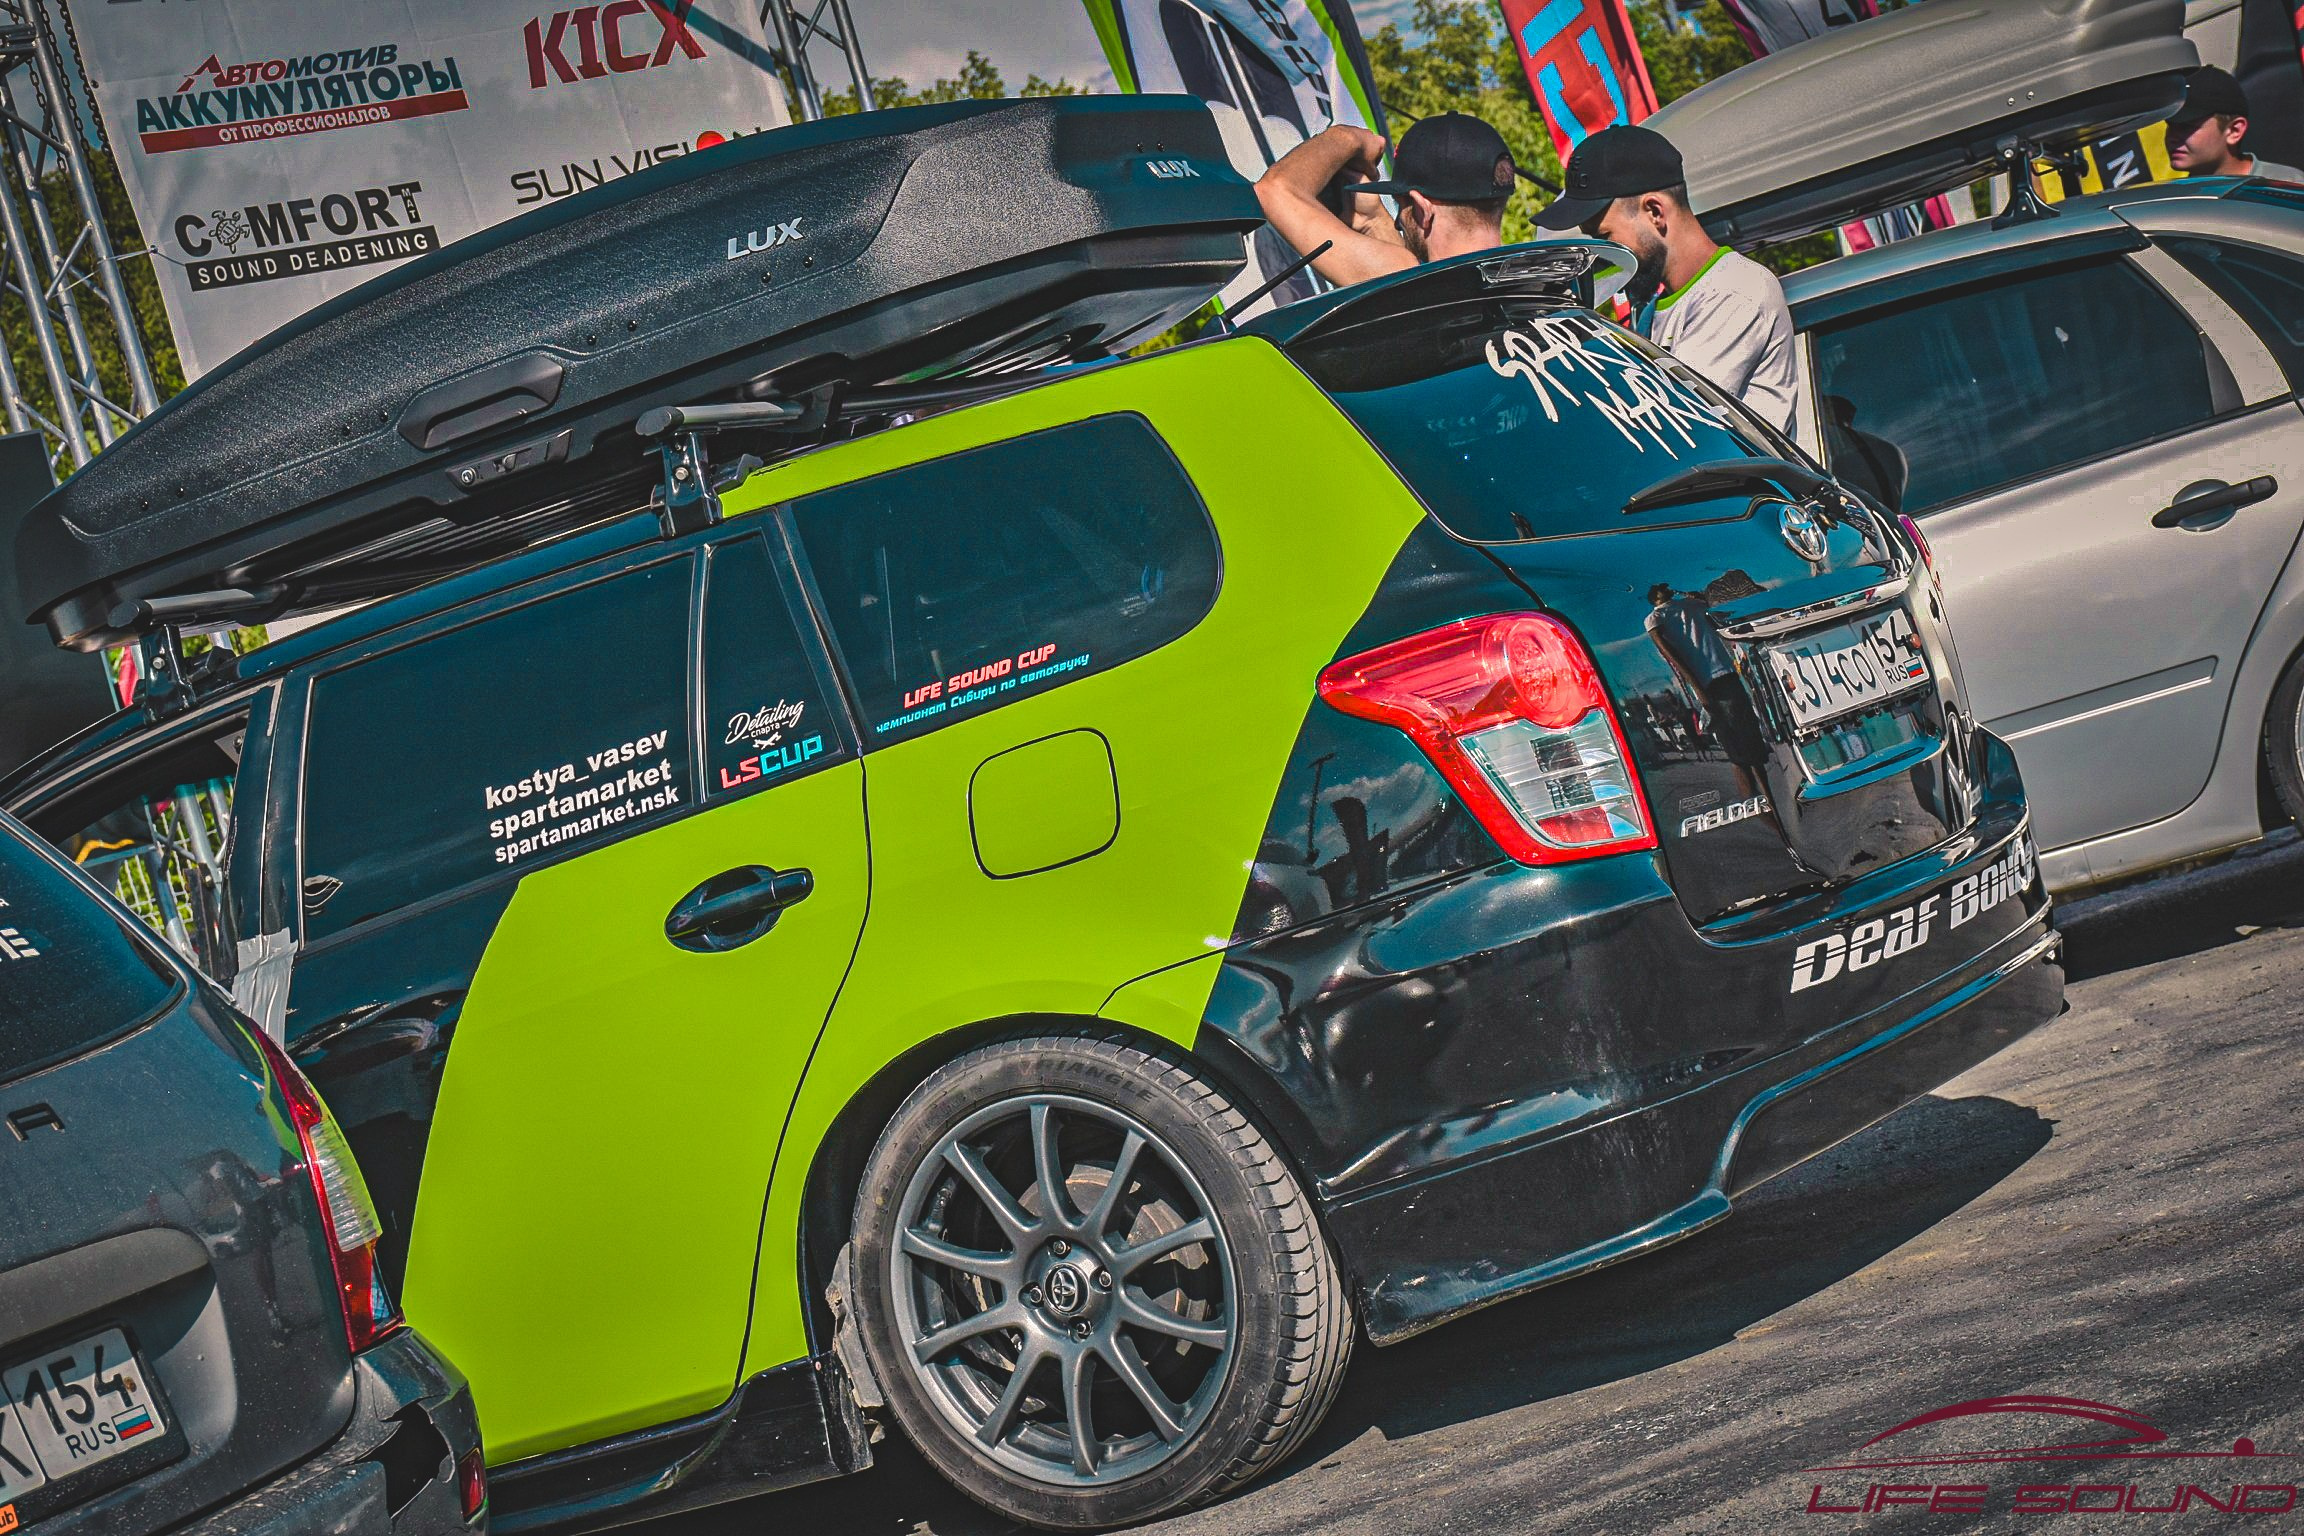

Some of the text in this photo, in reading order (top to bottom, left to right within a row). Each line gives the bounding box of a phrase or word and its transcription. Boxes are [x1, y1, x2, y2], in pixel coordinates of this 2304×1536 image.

[524, 0, 707, 89] KICX
[136, 57, 463, 133] АККУМУЛЯТОРЫ
[218, 105, 391, 142] ОТ ПРОФЕССИОНАЛОВ
[511, 159, 604, 204] SUN
[1145, 160, 1200, 179] LUX
[198, 233, 428, 284] SOUND DEADENING
[727, 216, 804, 260] LUX
[1861, 615, 1917, 668] 154
[904, 643, 1056, 709] LIFE SOUND CUP
[1000, 679, 1016, 691] по
[1884, 664, 1909, 685] RUS
[725, 699, 804, 744] Detailing
[485, 730, 668, 809] kostya_vasev
[489, 758, 672, 839] spartamarket
[1680, 795, 1773, 838] FIELDER
[495, 785, 680, 863] spartamarket.nsk
[23, 1345, 134, 1435] 154
[65, 1421, 117, 1459] RUS
